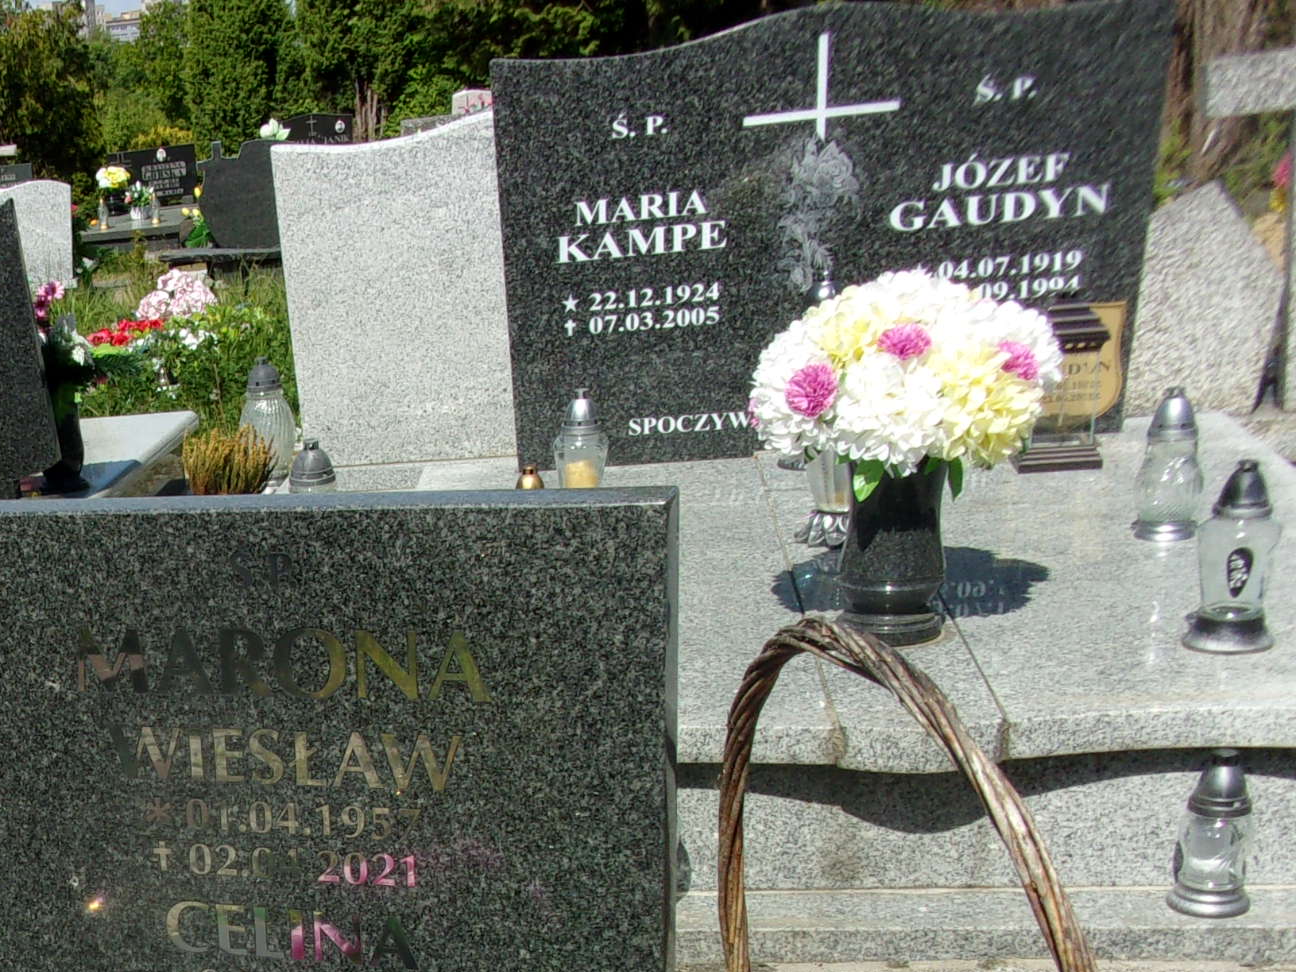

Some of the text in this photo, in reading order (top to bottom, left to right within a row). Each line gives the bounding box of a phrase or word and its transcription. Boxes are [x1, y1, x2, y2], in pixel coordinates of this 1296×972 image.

[1012, 76, 1038, 100] P.
[611, 112, 668, 139] Ś. P.
[932, 153, 1071, 192] JÓZEF
[574, 190, 708, 227] MARIA
[889, 182, 1112, 232] GAUDYN
[554, 220, 728, 264] KAMPE
[937, 250, 1083, 280] 04.07.1919
[589, 282, 720, 311] 22.12.1924
[978, 275, 1081, 301] 09.1994
[589, 306, 720, 335] 07.03.2005
[628, 411, 752, 436] SPOCZYW
[78, 629, 490, 700] MARONA
[109, 725, 463, 793] WIESŁAW
[165, 900, 421, 970] CELINA
